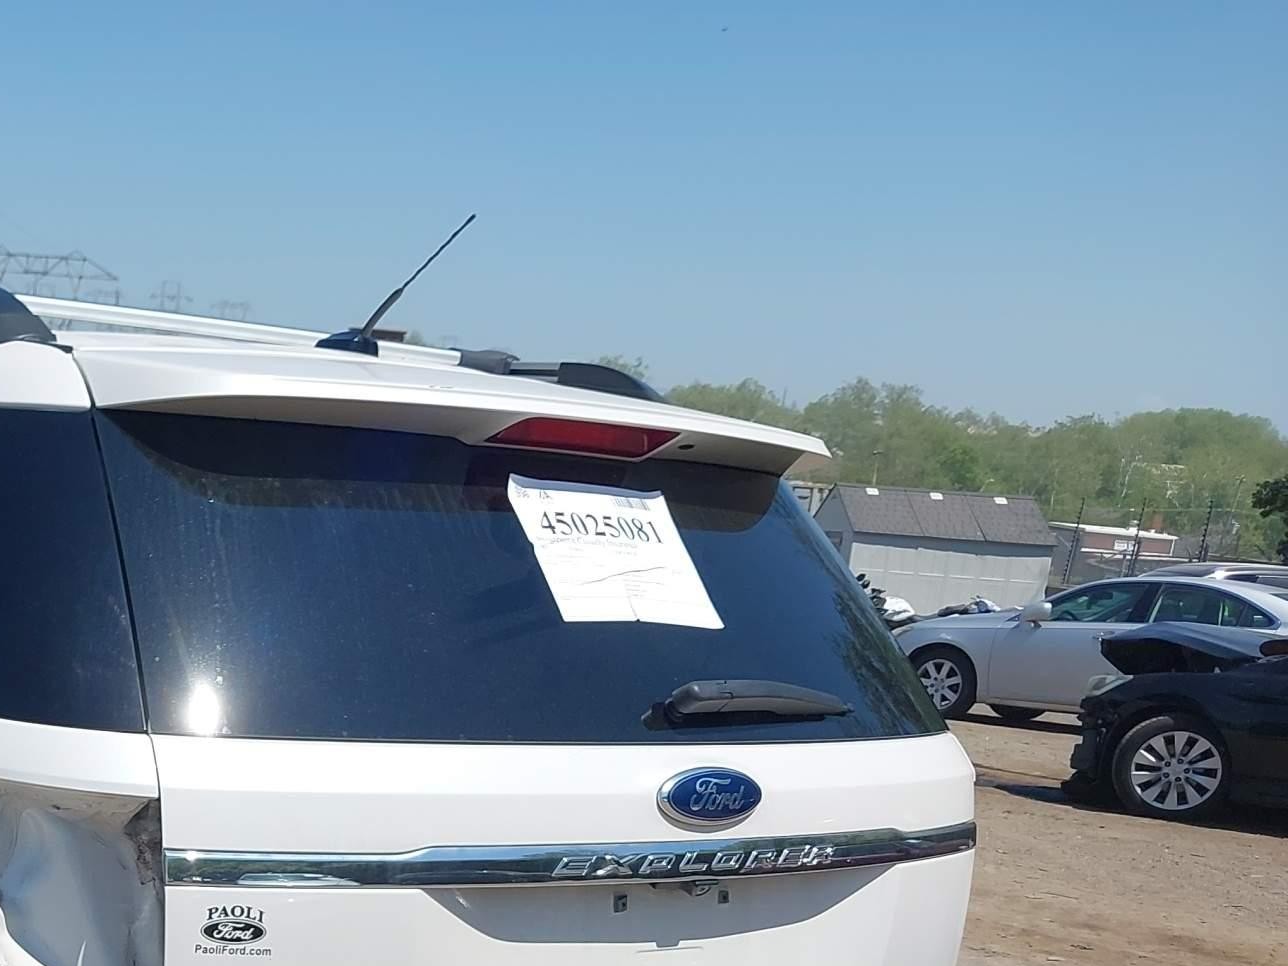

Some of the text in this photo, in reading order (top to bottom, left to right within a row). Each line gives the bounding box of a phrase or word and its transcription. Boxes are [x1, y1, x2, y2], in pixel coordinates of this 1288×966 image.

[540, 511, 663, 543] 45025081
[689, 776, 746, 812] Ford
[551, 844, 836, 878] EXPLORER
[206, 904, 265, 923] PAOLI
[212, 922, 255, 940] Ford
[194, 943, 272, 957] PaoliFord.com
